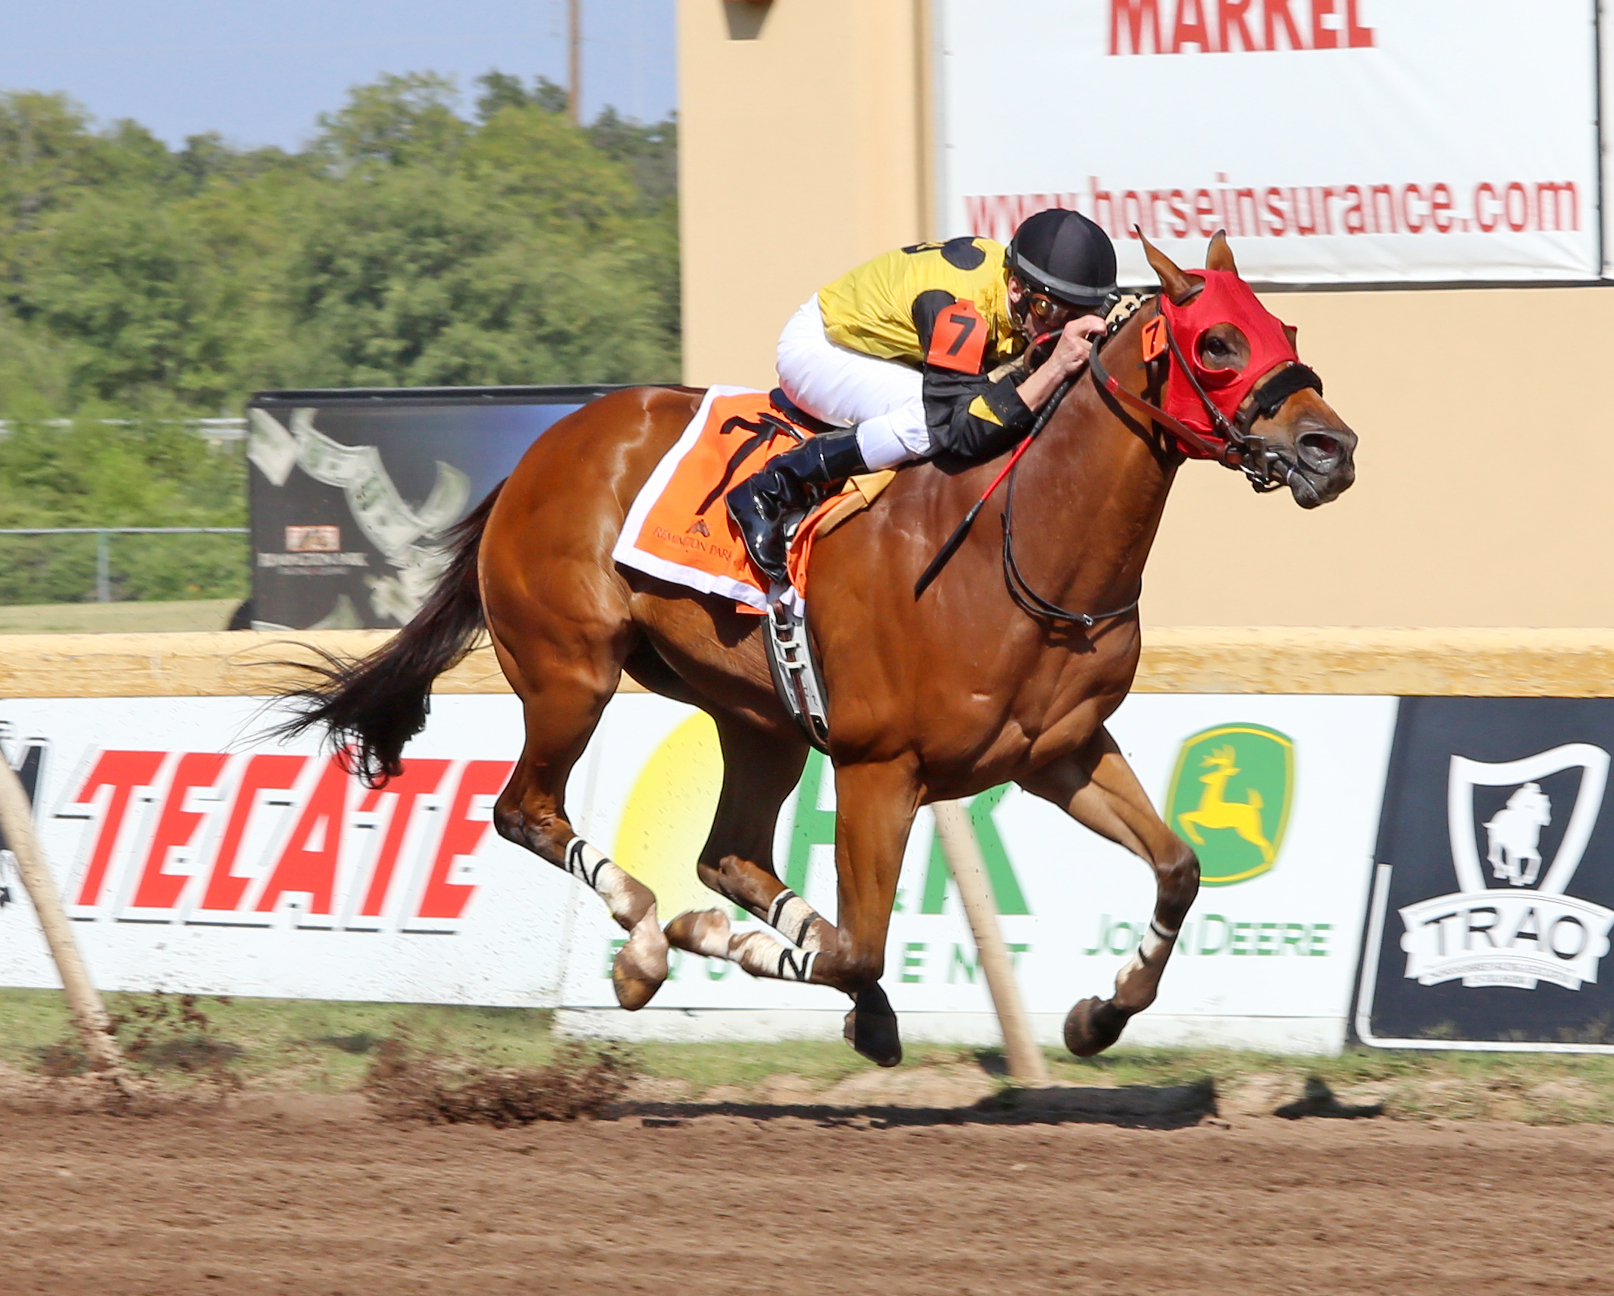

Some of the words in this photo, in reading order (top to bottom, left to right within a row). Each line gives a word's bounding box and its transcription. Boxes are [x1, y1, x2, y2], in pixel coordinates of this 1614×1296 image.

[1105, 0, 1379, 55] MARKEL
[963, 172, 1581, 240] wwhorseinsurance.com
[946, 313, 976, 357] 7
[1145, 317, 1161, 354] 7
[695, 414, 778, 516] 7
[74, 743, 518, 920] TECATE
[1198, 913, 1337, 957] DEERE
[1423, 905, 1588, 961] TRAO
